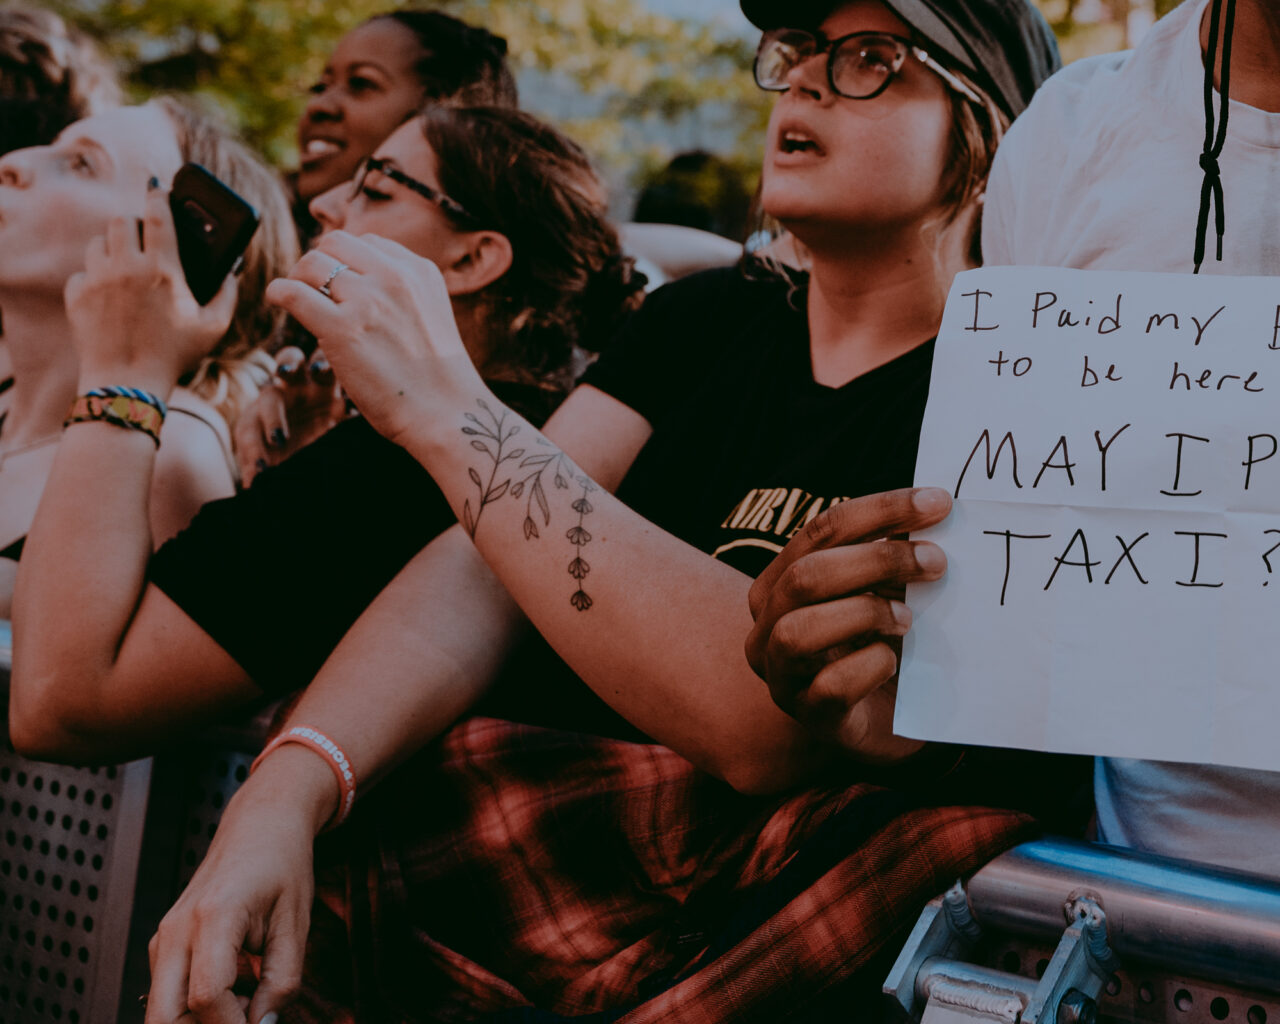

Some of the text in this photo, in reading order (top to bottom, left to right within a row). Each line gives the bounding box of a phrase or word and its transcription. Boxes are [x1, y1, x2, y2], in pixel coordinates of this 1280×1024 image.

[961, 289, 999, 332] I
[1032, 291, 1122, 335] Paid
[1146, 305, 1226, 345] my
[989, 350, 1264, 393] to be here
[954, 424, 1131, 500] MAY
[1160, 433, 1209, 496] I
